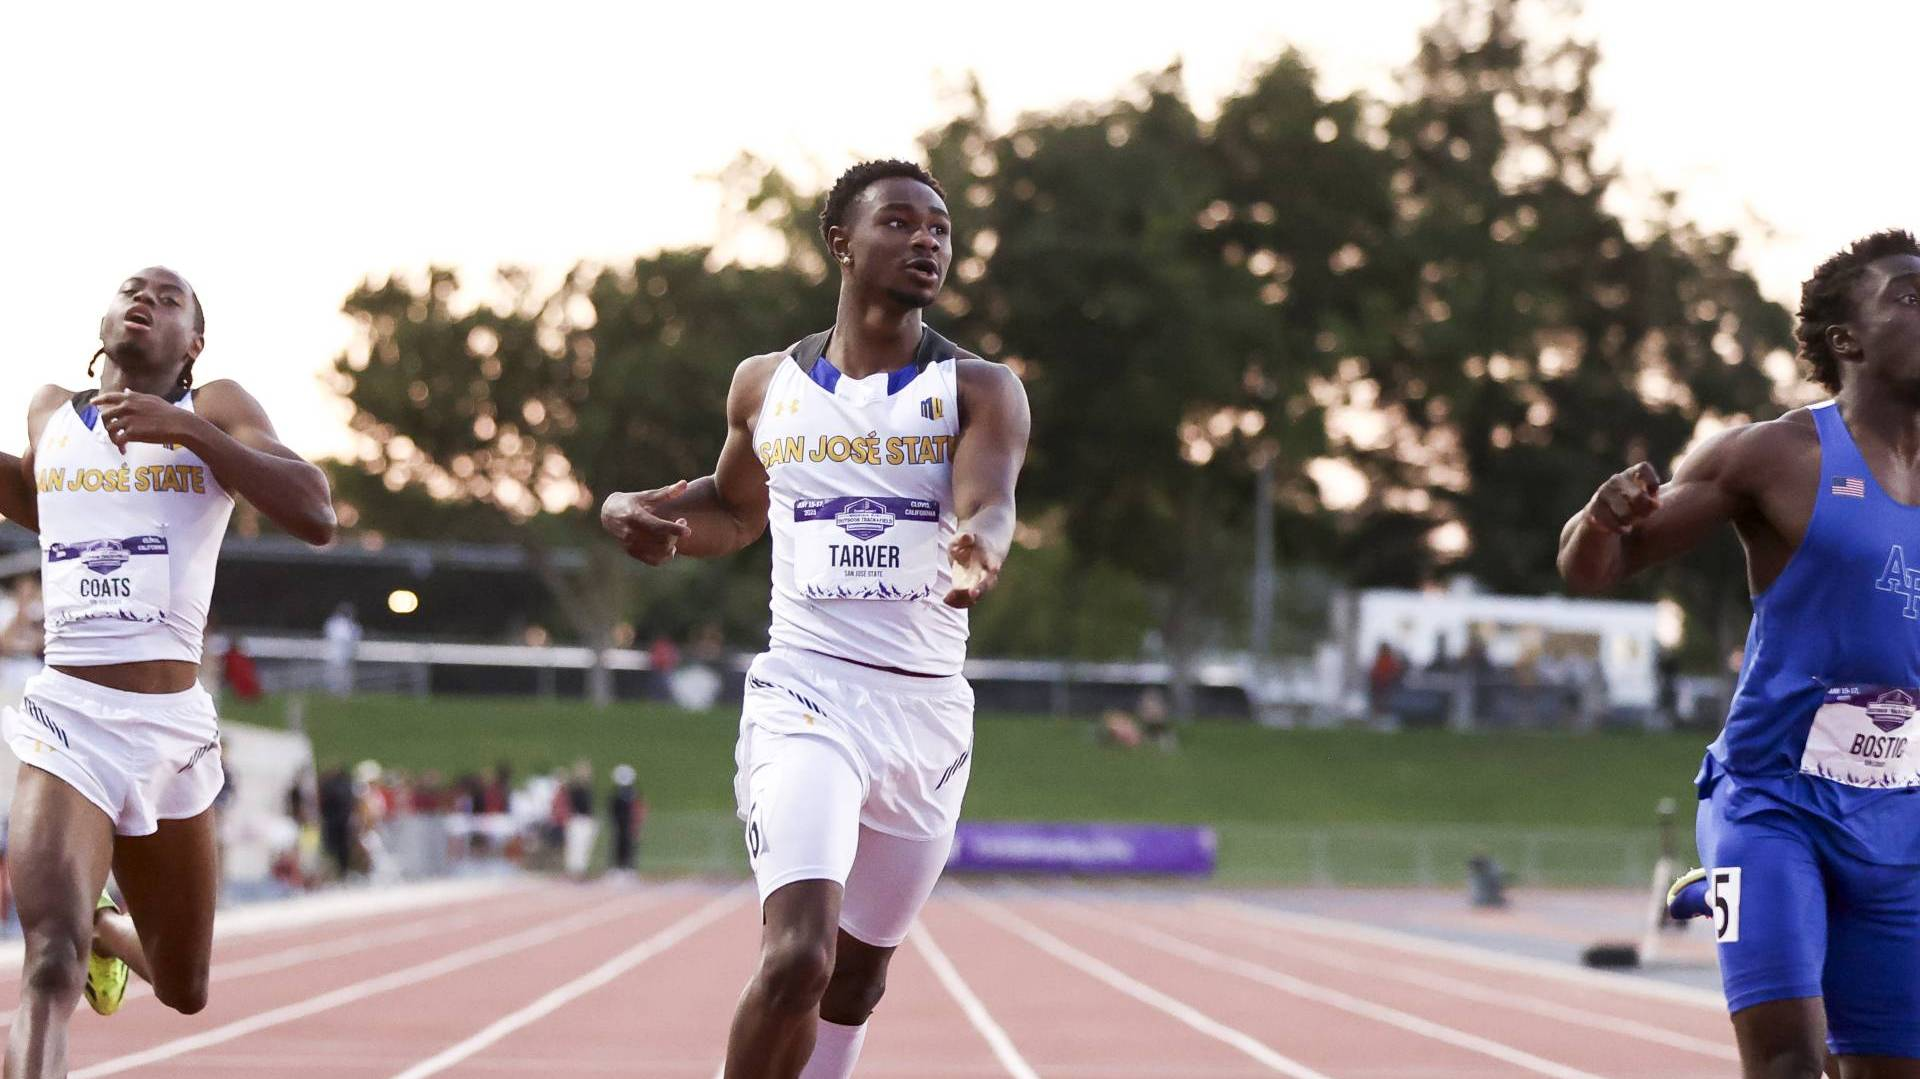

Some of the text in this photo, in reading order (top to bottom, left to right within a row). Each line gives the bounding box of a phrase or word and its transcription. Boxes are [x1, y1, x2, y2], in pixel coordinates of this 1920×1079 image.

[759, 430, 953, 470] SAN JOSÉ STAT
[37, 462, 205, 494] AN JOSÉ STATE
[829, 545, 899, 568] TARVER
[80, 578, 130, 597] COATS
[1850, 733, 1907, 758] BOSTIC
[1715, 874, 1729, 939] 5
